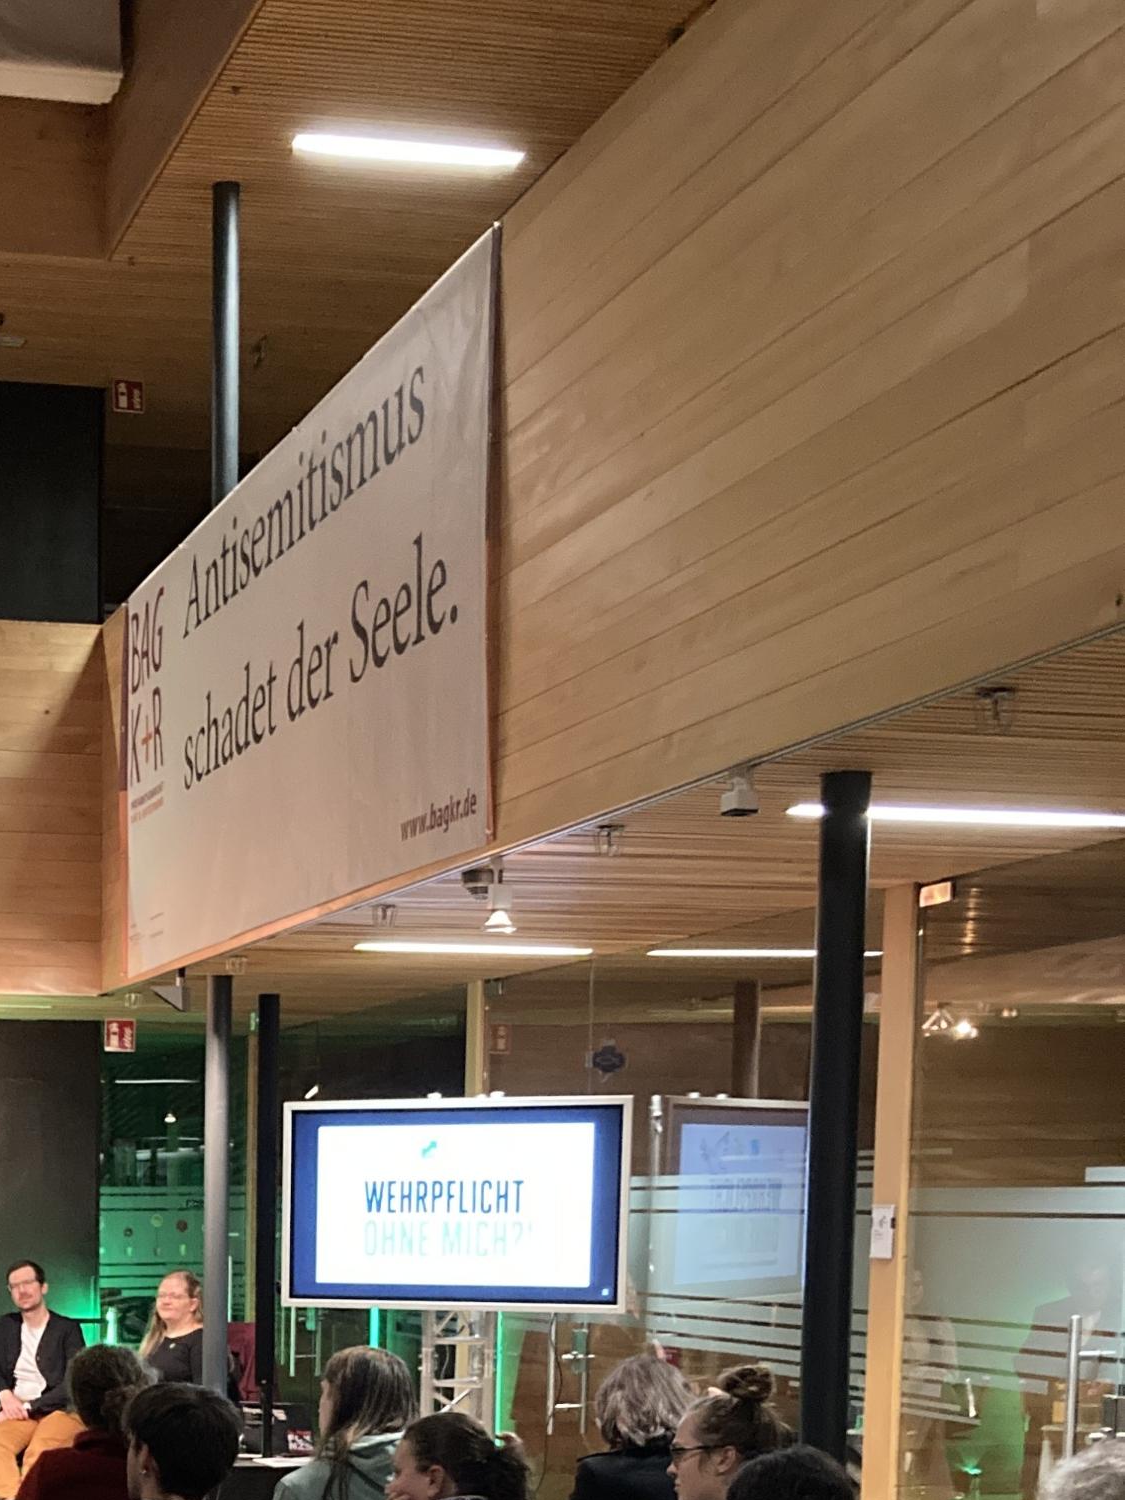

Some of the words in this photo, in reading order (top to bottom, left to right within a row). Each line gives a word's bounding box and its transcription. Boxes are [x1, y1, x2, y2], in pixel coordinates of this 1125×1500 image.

[183, 366, 425, 639] Antisemitismus
[130, 586, 165, 695] BAG
[183, 660, 277, 791] schadet
[286, 618, 339, 723] der
[349, 532, 459, 683] Seele.
[129, 685, 164, 787] K+R
[400, 787, 477, 841] www.bagkr.de
[364, 1180, 525, 1214] WEHRPFLICHT
[364, 1219, 430, 1257] OHNE
